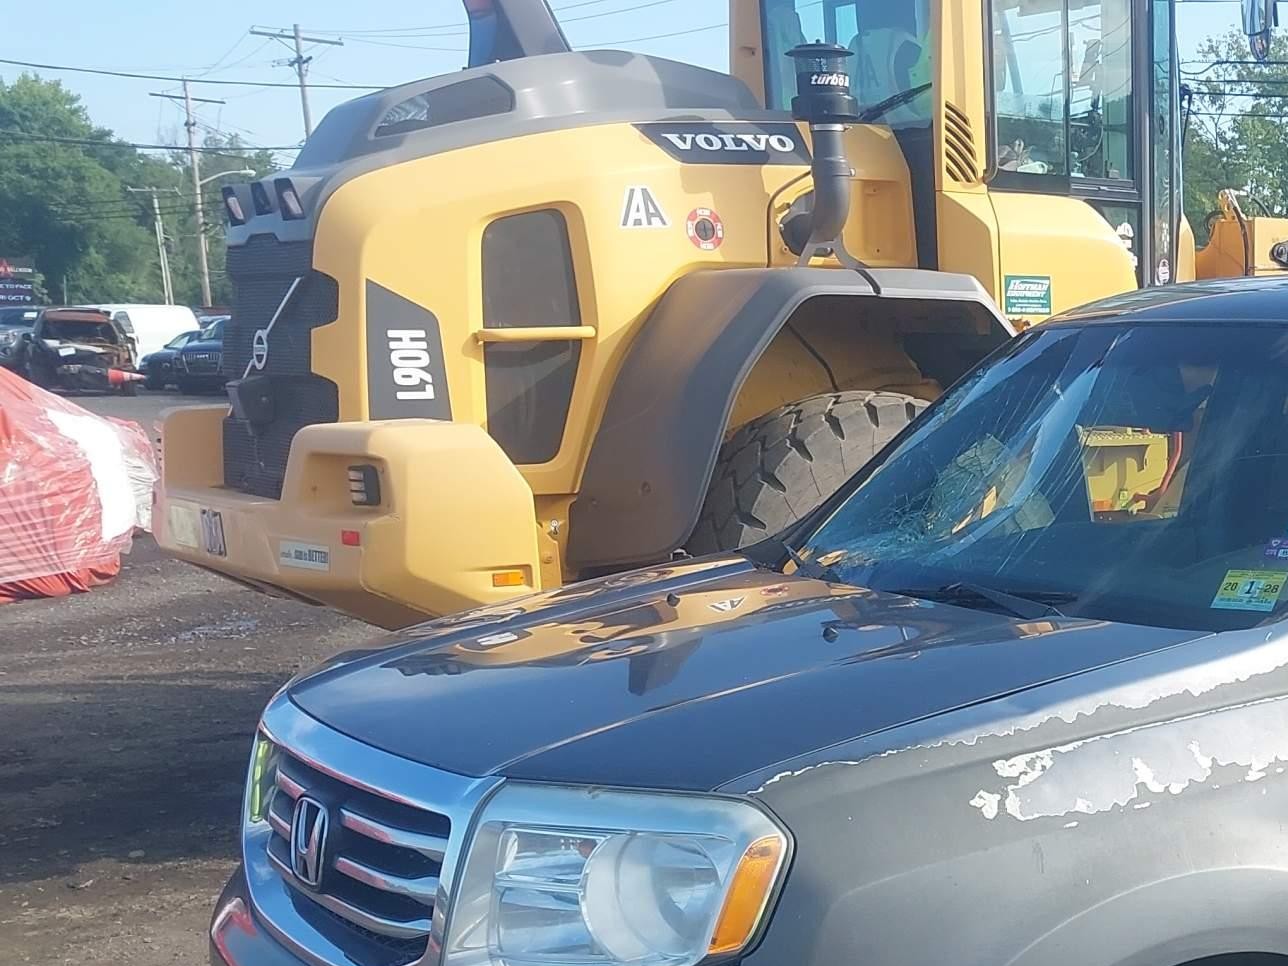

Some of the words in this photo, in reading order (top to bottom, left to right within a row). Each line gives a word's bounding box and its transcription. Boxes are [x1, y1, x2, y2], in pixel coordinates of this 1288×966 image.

[661, 133, 795, 152] VOLVO
[386, 329, 435, 400] L90H
[1223, 581, 1239, 592] 20
[1263, 583, 1280, 594] 28
